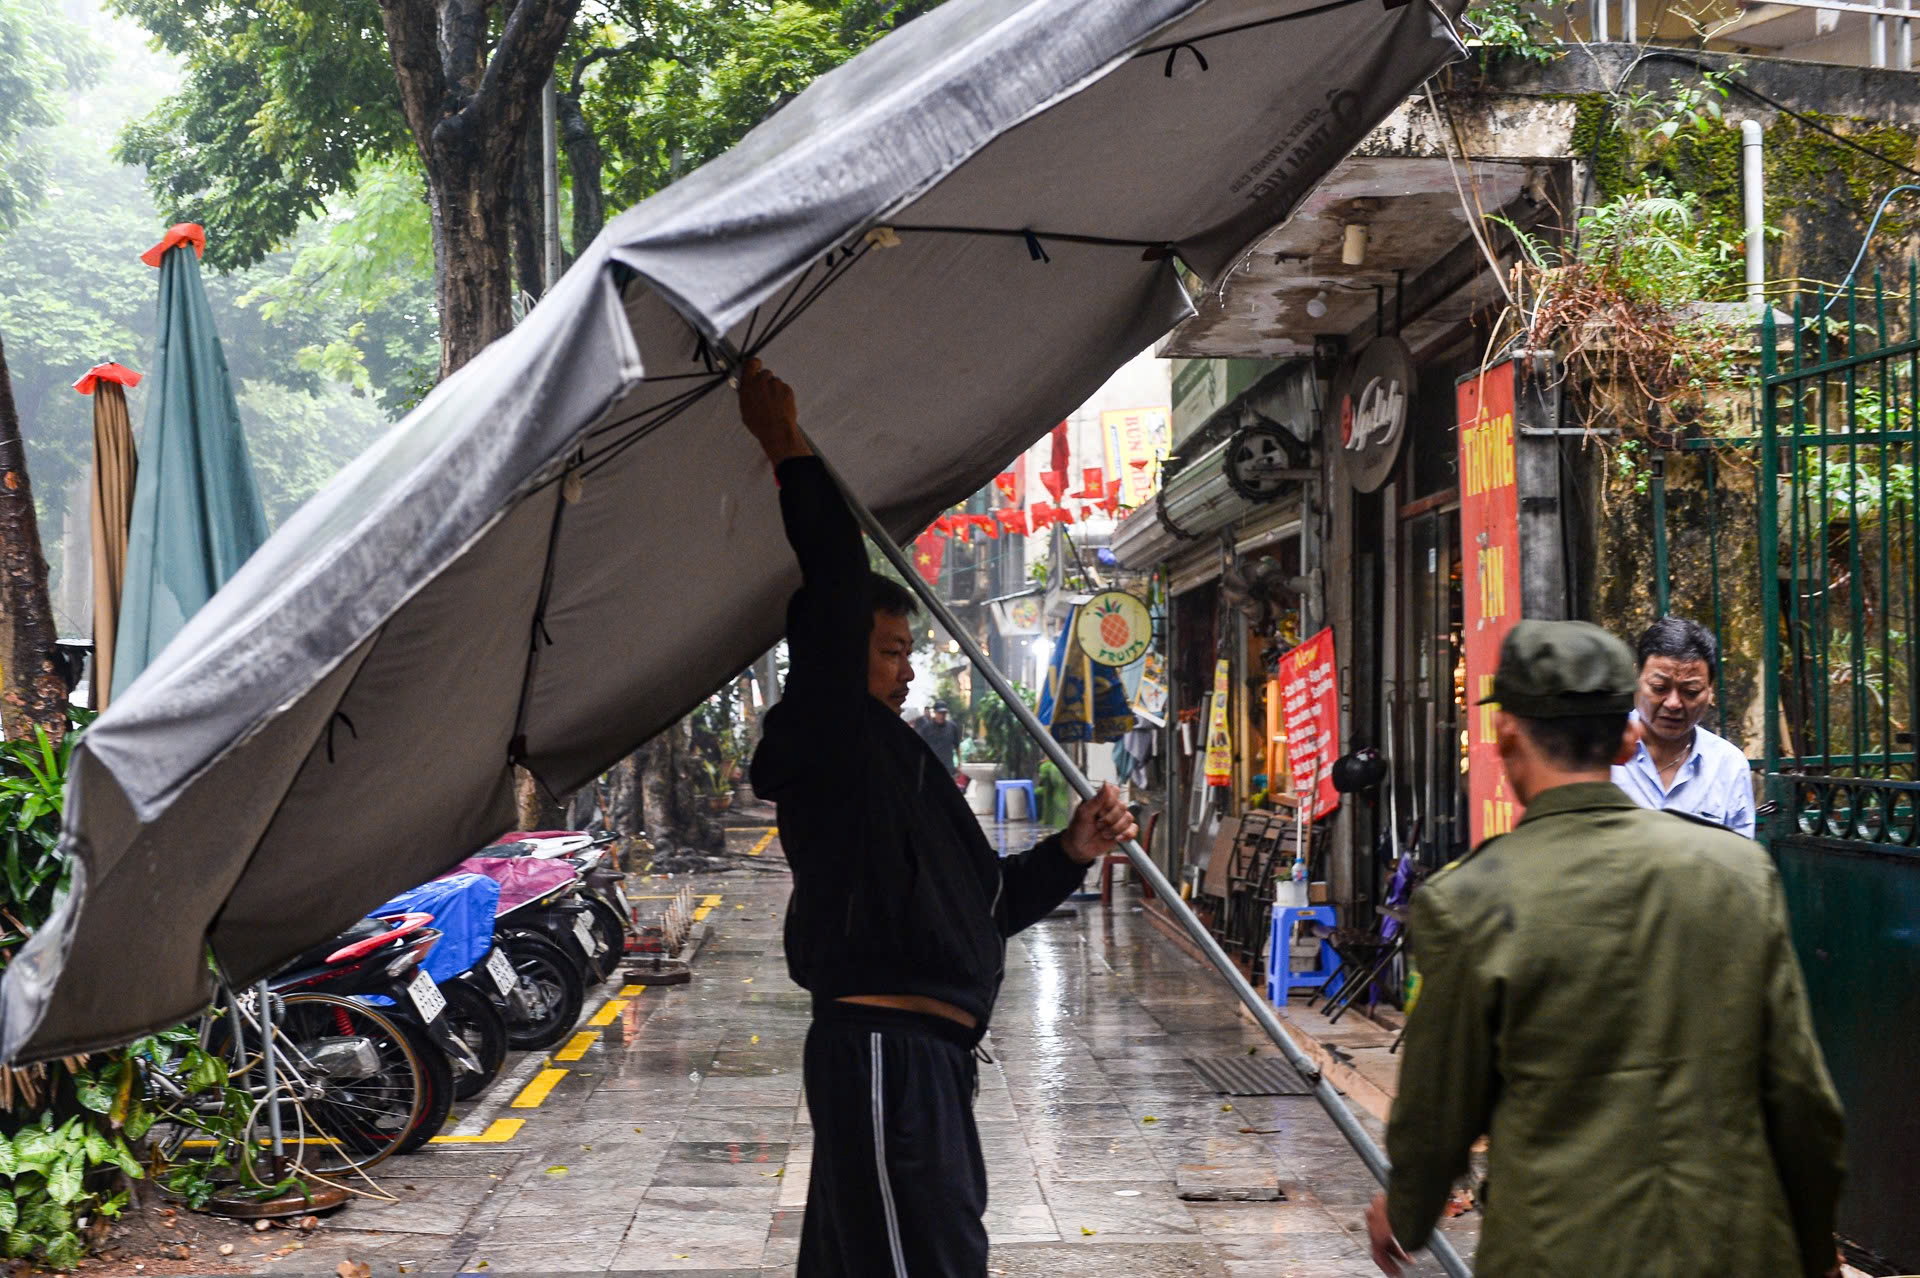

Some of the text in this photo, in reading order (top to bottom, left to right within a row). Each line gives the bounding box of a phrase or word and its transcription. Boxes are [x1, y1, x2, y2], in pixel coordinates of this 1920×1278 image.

[1463, 407, 1514, 497] THÔNG
[1099, 641, 1144, 662] FRUITS
[1294, 645, 1319, 671] New
